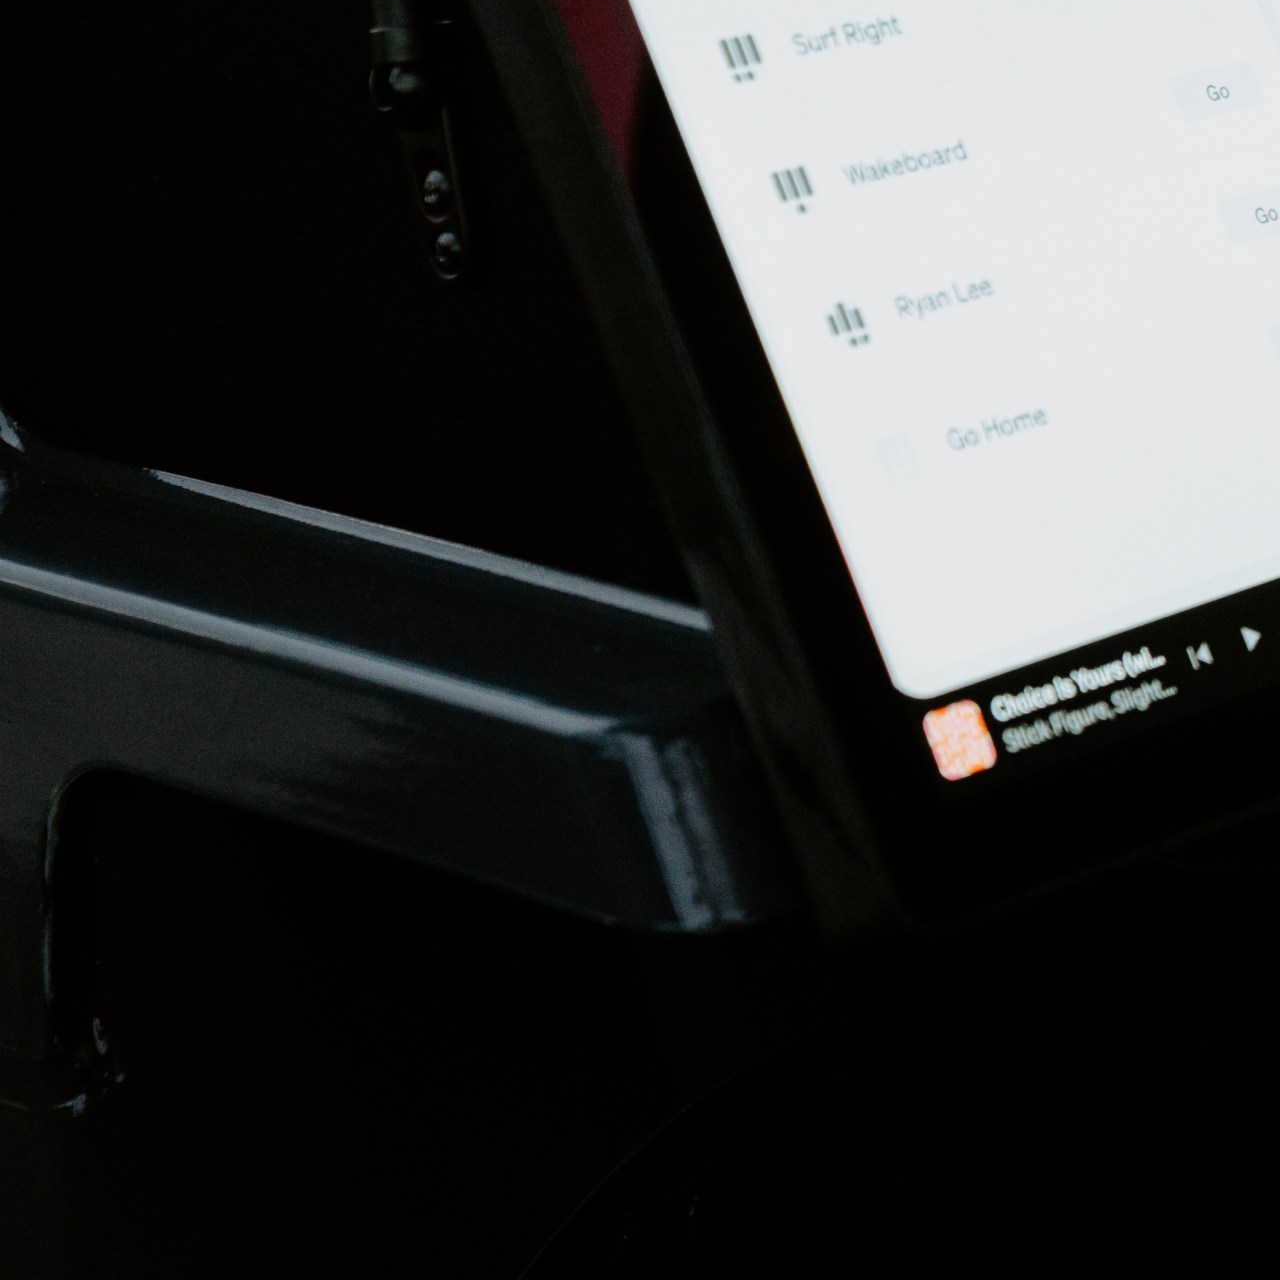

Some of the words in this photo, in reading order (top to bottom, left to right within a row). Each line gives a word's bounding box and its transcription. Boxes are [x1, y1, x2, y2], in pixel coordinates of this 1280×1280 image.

[791, 28, 839, 58] Surf
[841, 13, 903, 48] Right
[1205, 83, 1231, 102] Go
[842, 138, 969, 187] Wakeboard
[1254, 206, 1279, 225] Go
[894, 288, 949, 322] Ryan
[953, 278, 994, 304] Lee
[946, 423, 981, 453] Go
[985, 407, 1048, 442] Home
